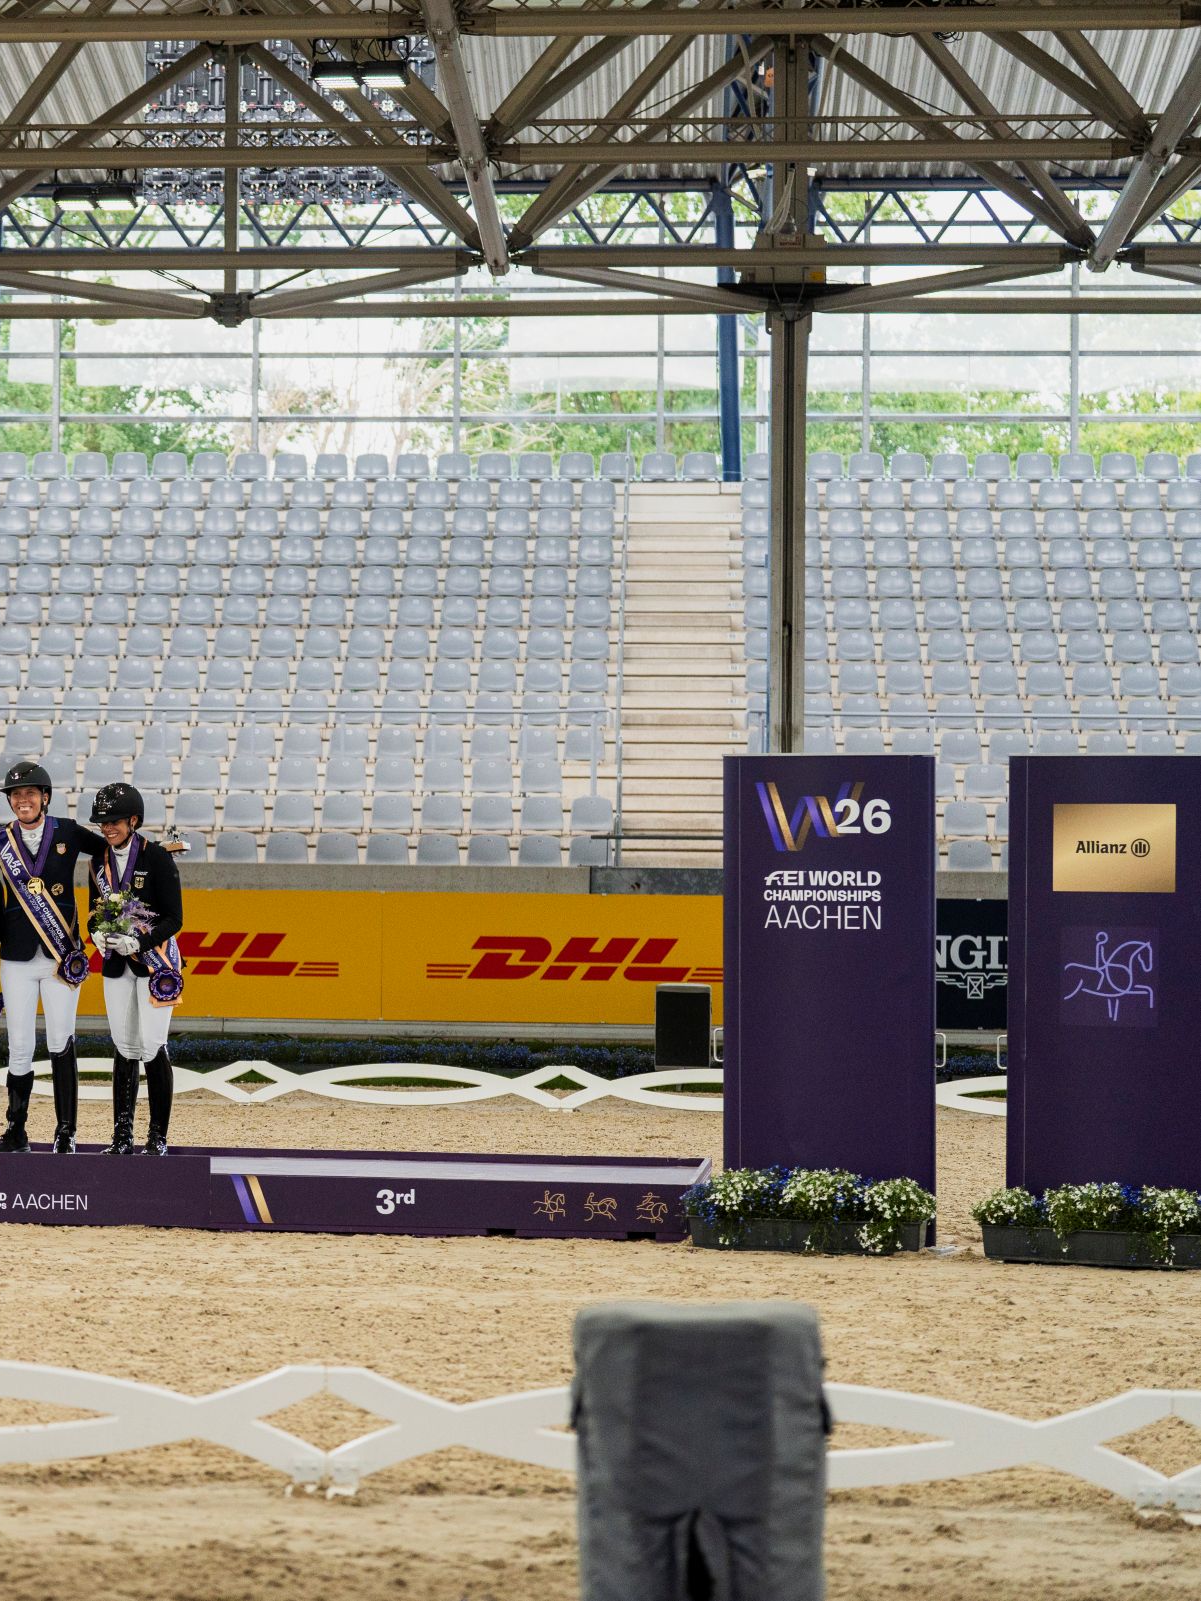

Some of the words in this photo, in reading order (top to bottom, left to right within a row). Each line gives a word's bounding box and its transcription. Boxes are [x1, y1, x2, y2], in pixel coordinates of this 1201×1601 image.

[1075, 841, 1127, 854] Allianz
[764, 871, 804, 886] FEI
[809, 871, 881, 886] WORLD
[763, 890, 882, 902] CHAMPIONSHIPS
[42, 907, 65, 939] CHAMPION
[764, 904, 881, 930] AACHEN
[467, 936, 692, 981] DHL
[12, 1193, 88, 1211] AACHEN
[376, 1188, 415, 1215] 3rd
